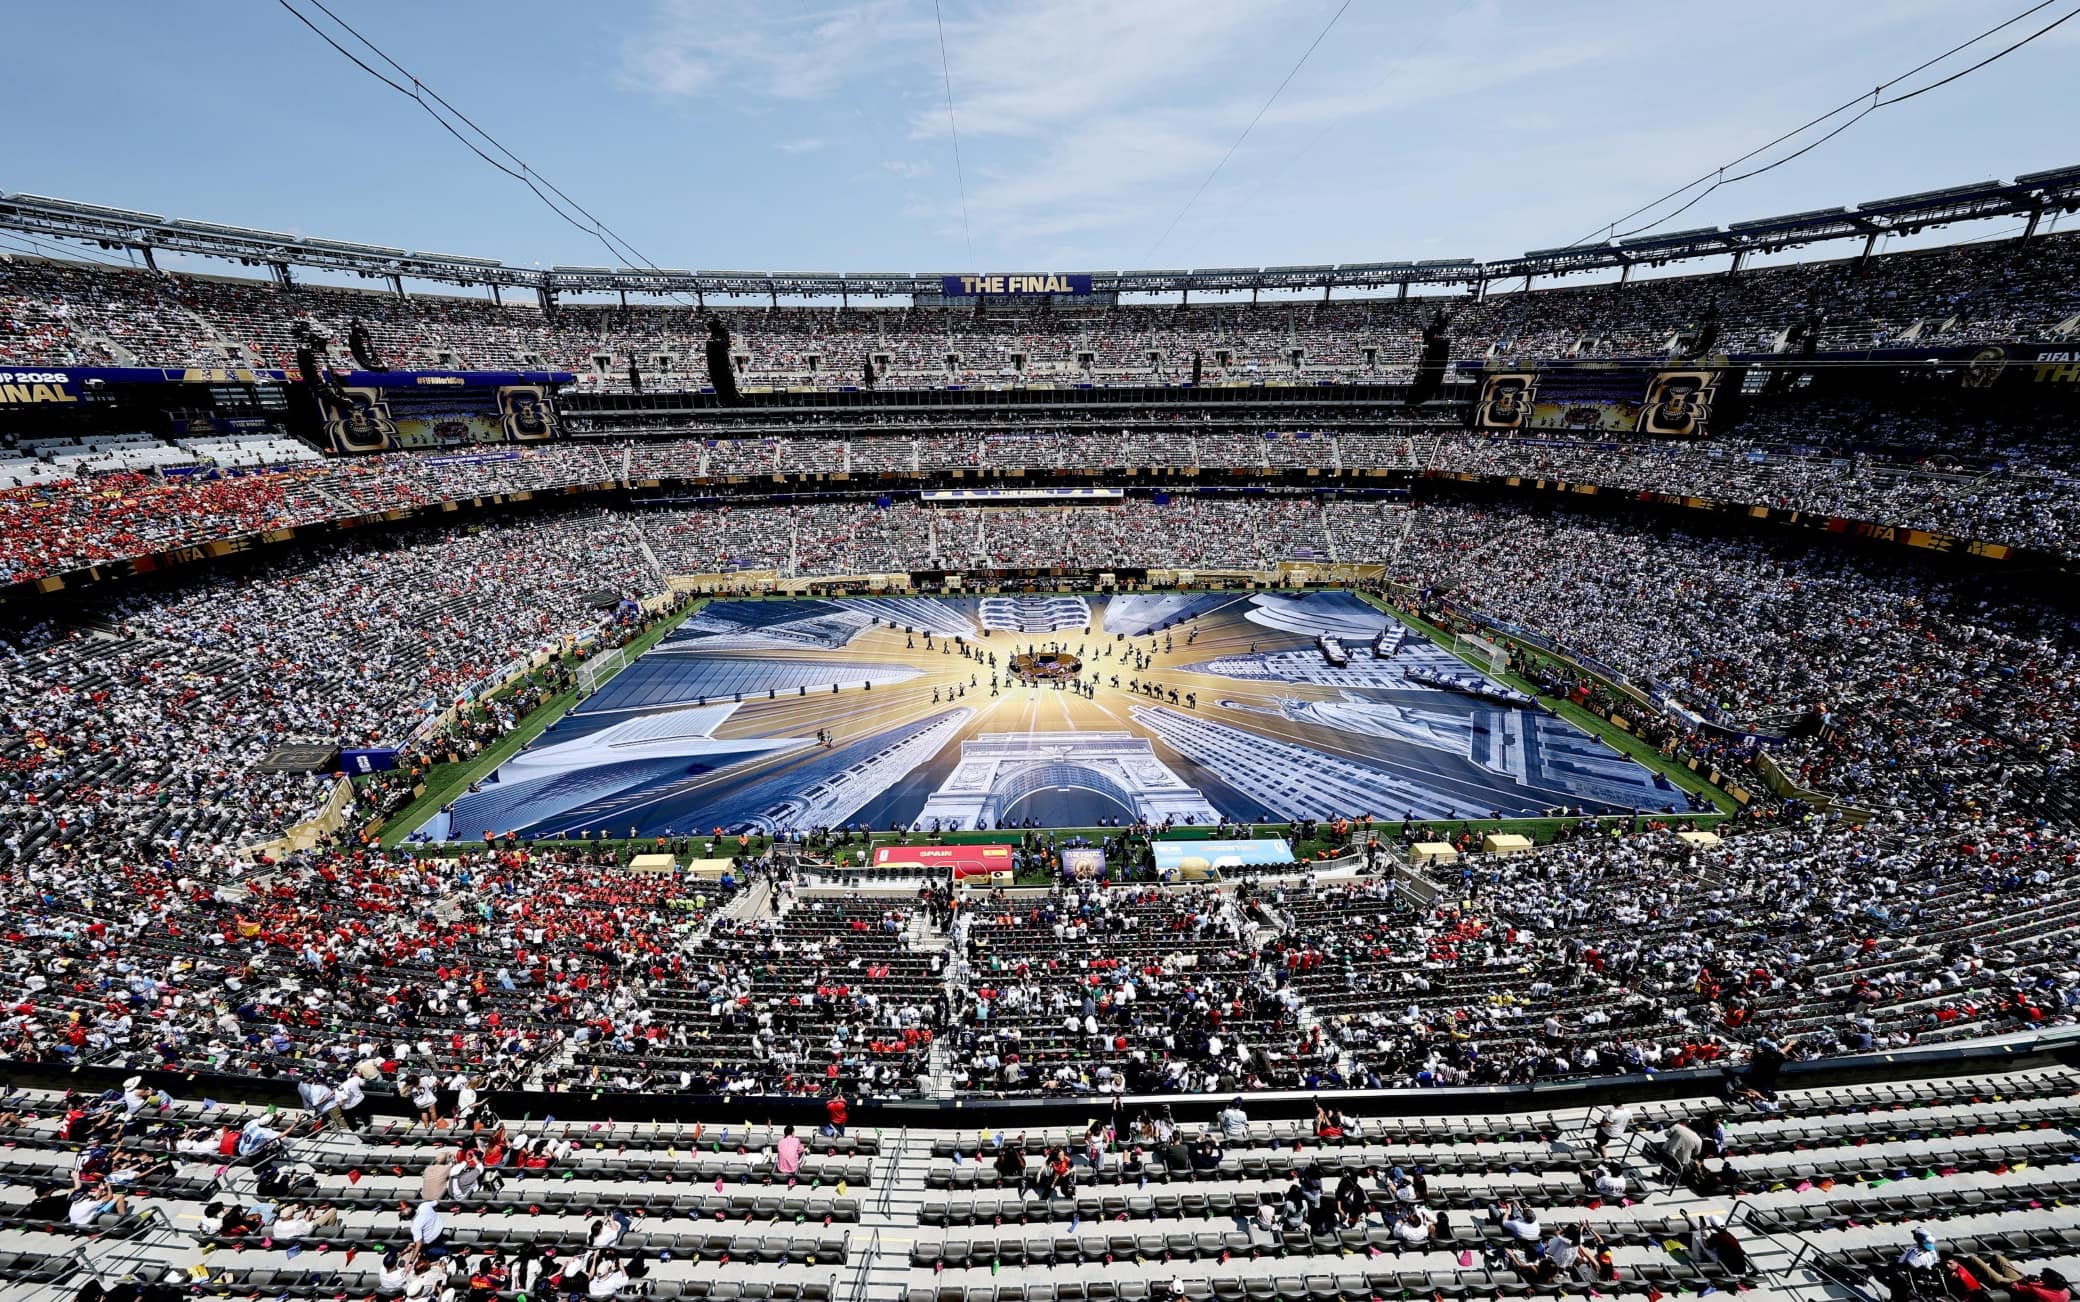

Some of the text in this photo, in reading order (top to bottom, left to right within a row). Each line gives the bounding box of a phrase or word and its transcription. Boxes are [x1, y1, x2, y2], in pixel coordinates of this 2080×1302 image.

[960, 275, 1073, 293] THE FINAL
[2037, 352, 2069, 362] FIFA
[15, 373, 69, 383] 2026
[1857, 523, 1895, 542] FIFA
[167, 547, 205, 567] FIFA
